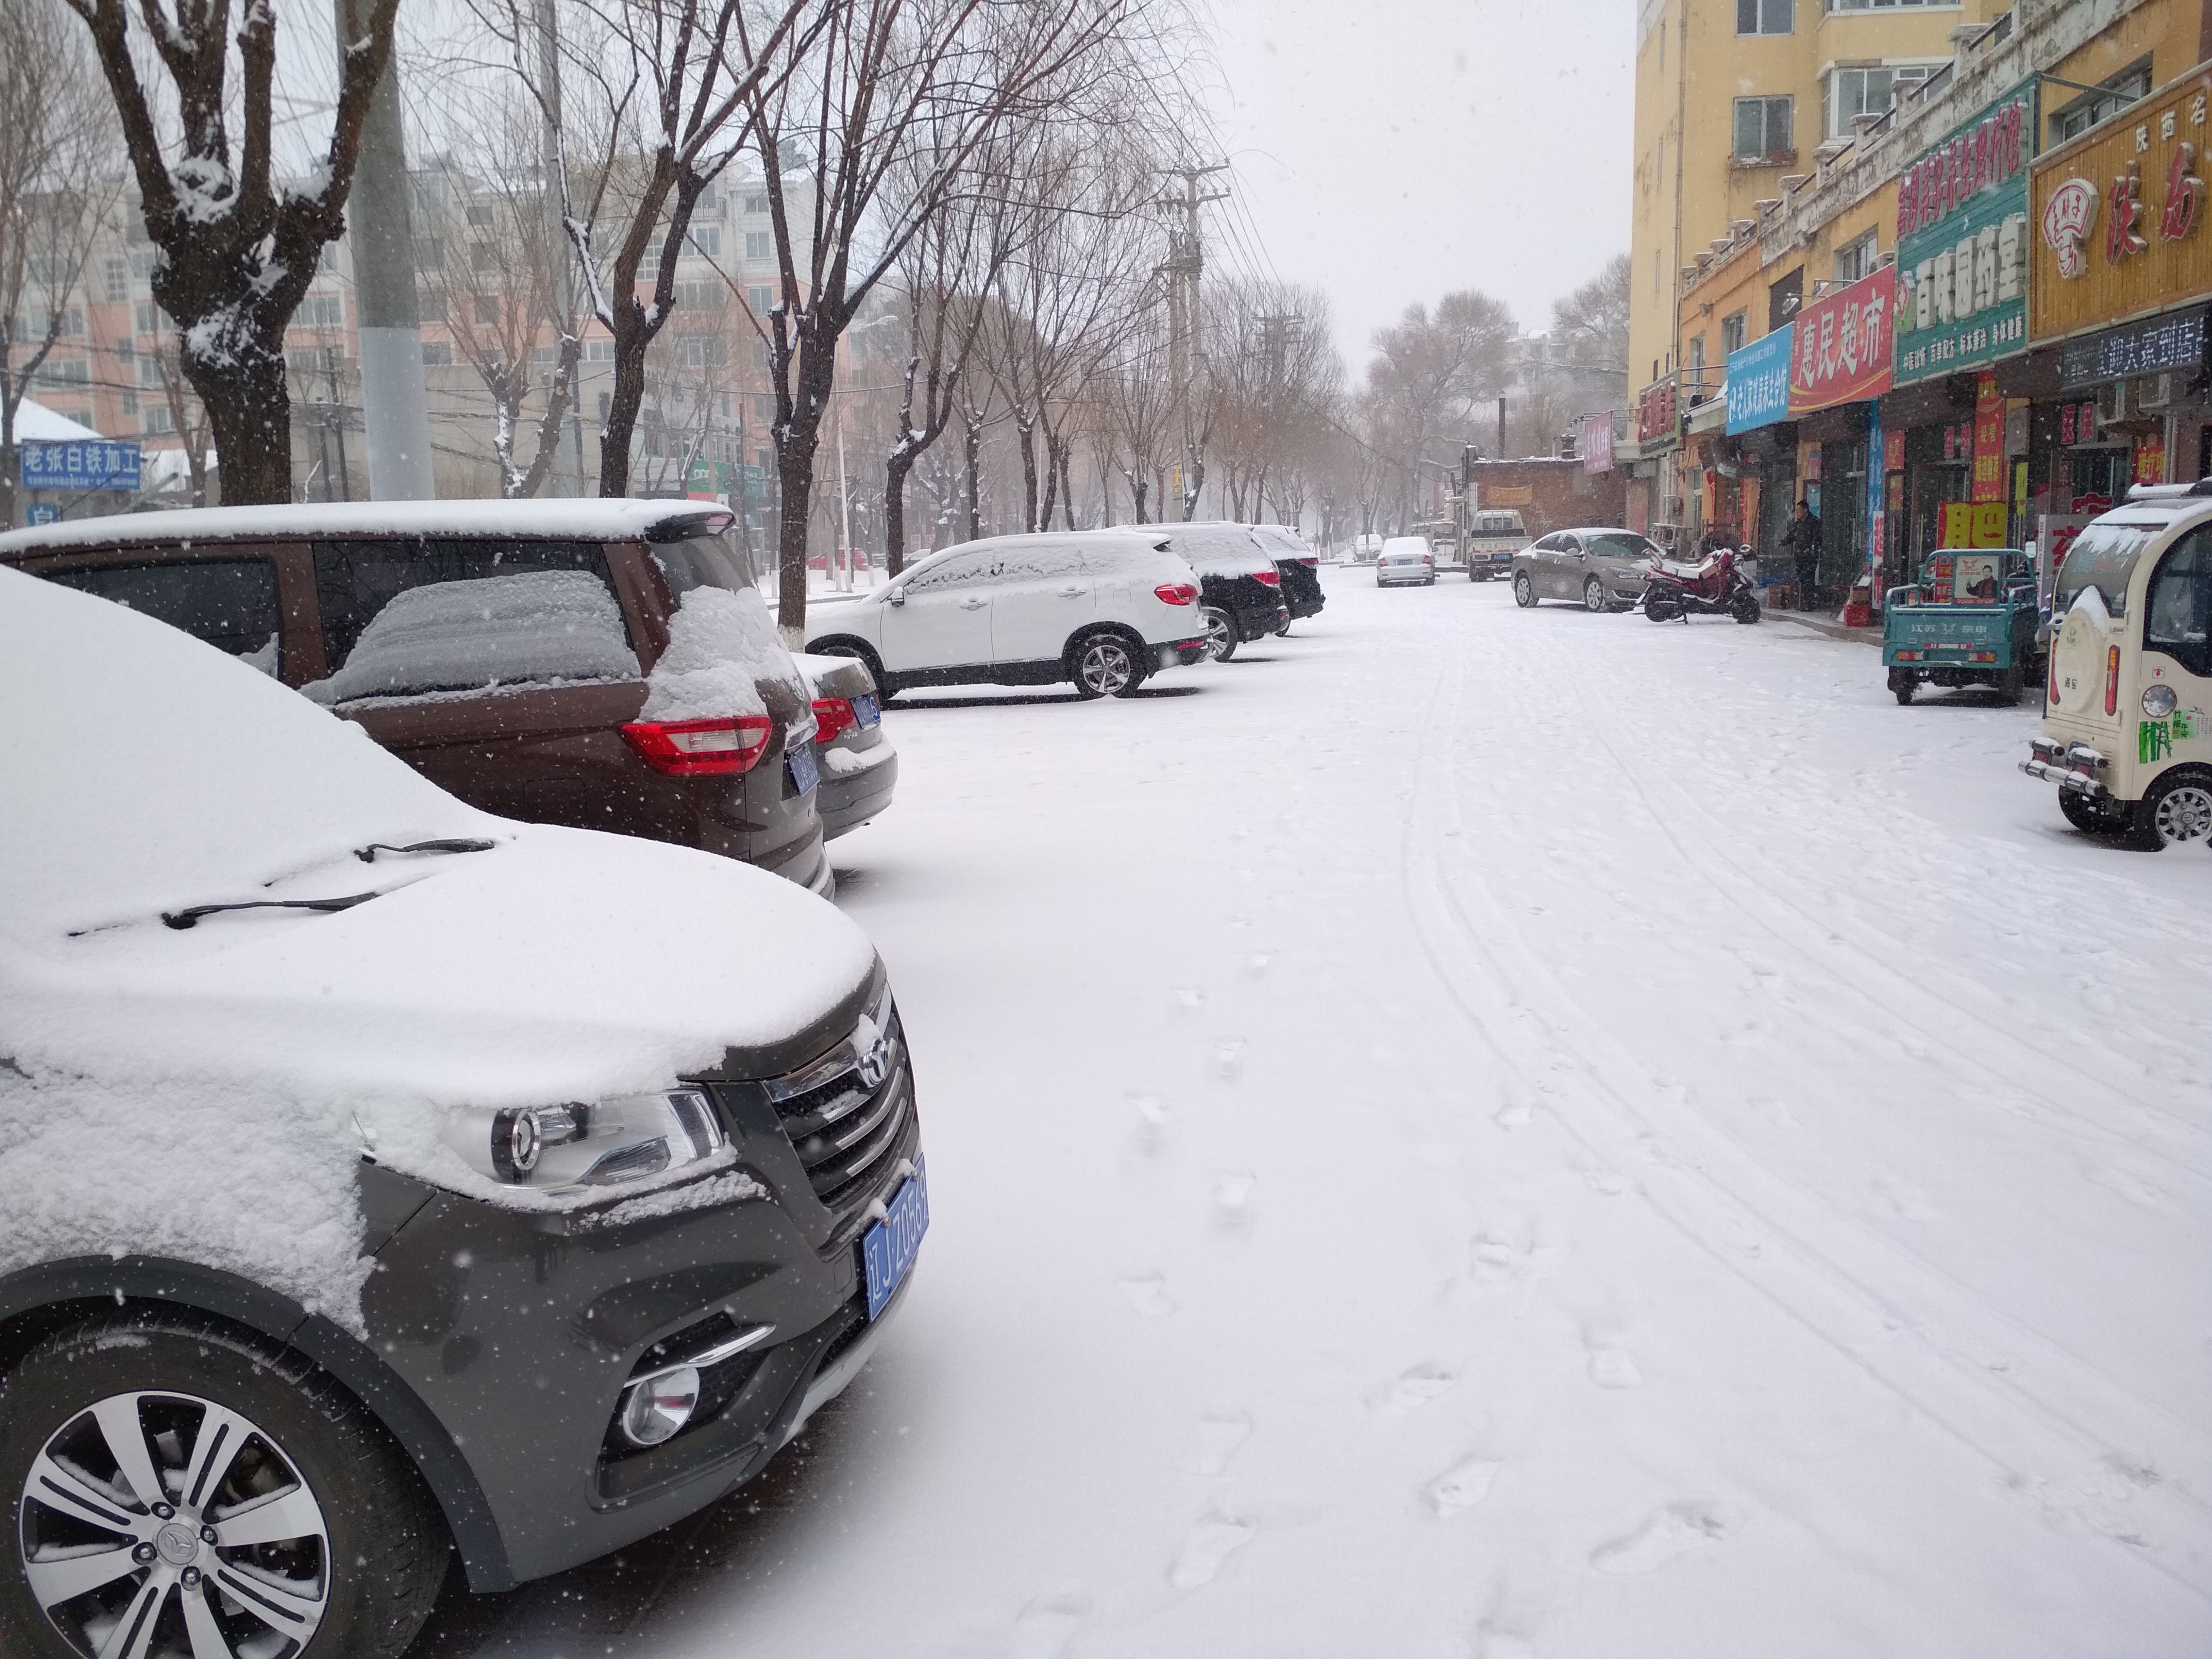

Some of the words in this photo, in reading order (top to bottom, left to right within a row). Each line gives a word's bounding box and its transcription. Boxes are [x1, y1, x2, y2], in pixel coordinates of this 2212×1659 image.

[1916, 215, 2021, 330] 百味园药堂
[1798, 287, 1886, 388] 惠民超市
[1993, 314, 2023, 346] 身体健康
[2061, 402, 2093, 445] 医保
[26, 446, 138, 473] 老张白铁加工
[1943, 502, 2007, 549] 肥
[1912, 624, 1936, 633] 江苏
[1962, 625, 1987, 634] 宗申
[2173, 710, 2182, 728] 竹报
[2181, 723, 2188, 738] 平安
